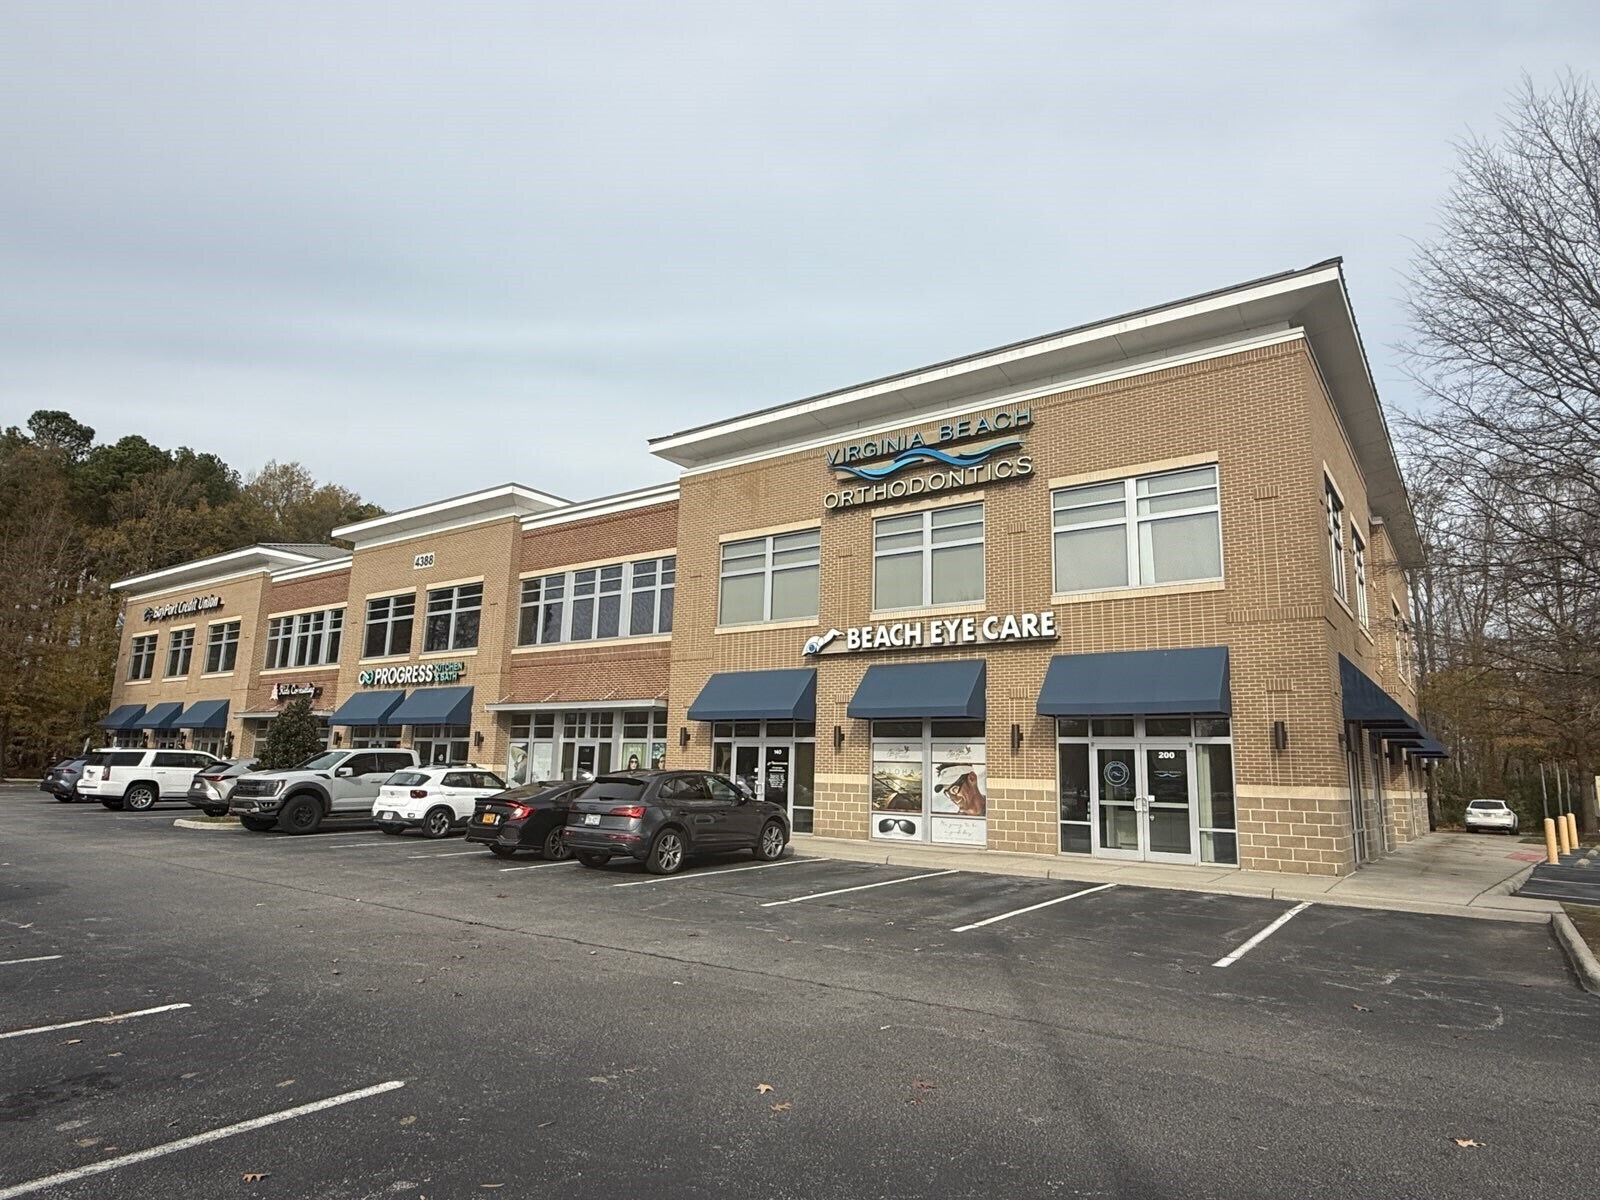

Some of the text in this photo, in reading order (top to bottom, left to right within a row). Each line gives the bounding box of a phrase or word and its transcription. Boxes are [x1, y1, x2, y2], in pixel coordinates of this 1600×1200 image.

[825, 408, 1032, 466] VIRGINIA BEACH
[823, 455, 1034, 510] ORTHODONTICS
[415, 554, 434, 567] 4388
[153, 595, 220, 620] BayPort Credit Union
[846, 611, 1056, 650] BEACH EYE CARE
[374, 663, 434, 685] PROGRESS
[434, 661, 464, 672] KITCHEN
[440, 672, 458, 681] BATH
[1157, 751, 1176, 760] 200
